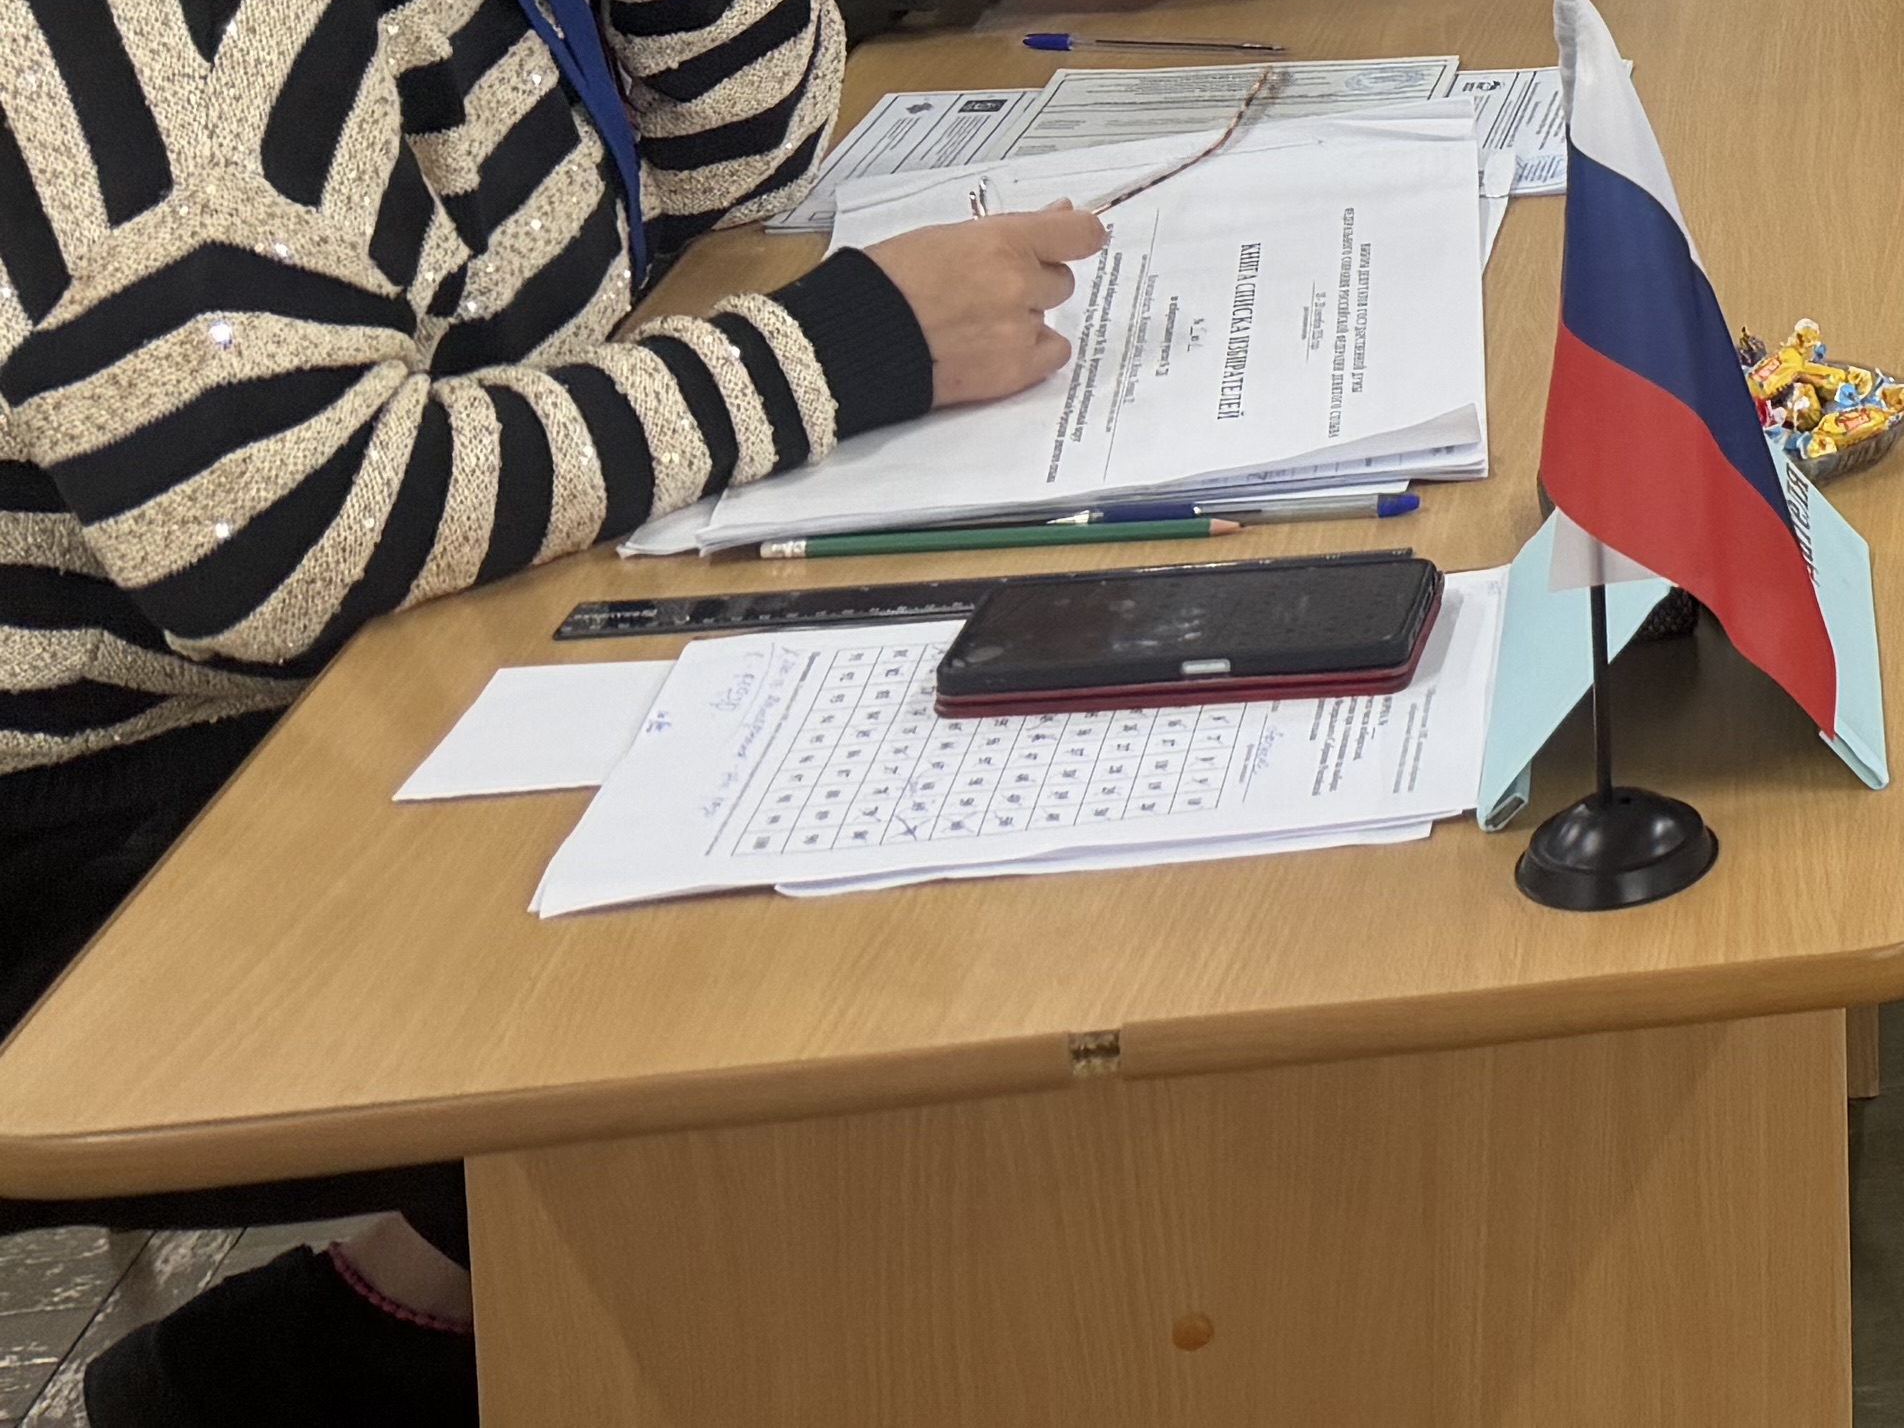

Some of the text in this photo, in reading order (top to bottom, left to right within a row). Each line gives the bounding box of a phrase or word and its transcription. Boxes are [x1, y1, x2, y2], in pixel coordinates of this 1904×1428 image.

[1217, 243, 1261, 420] КНИГА СПИСКА ИЗБИРАТЕЛЕЙ
